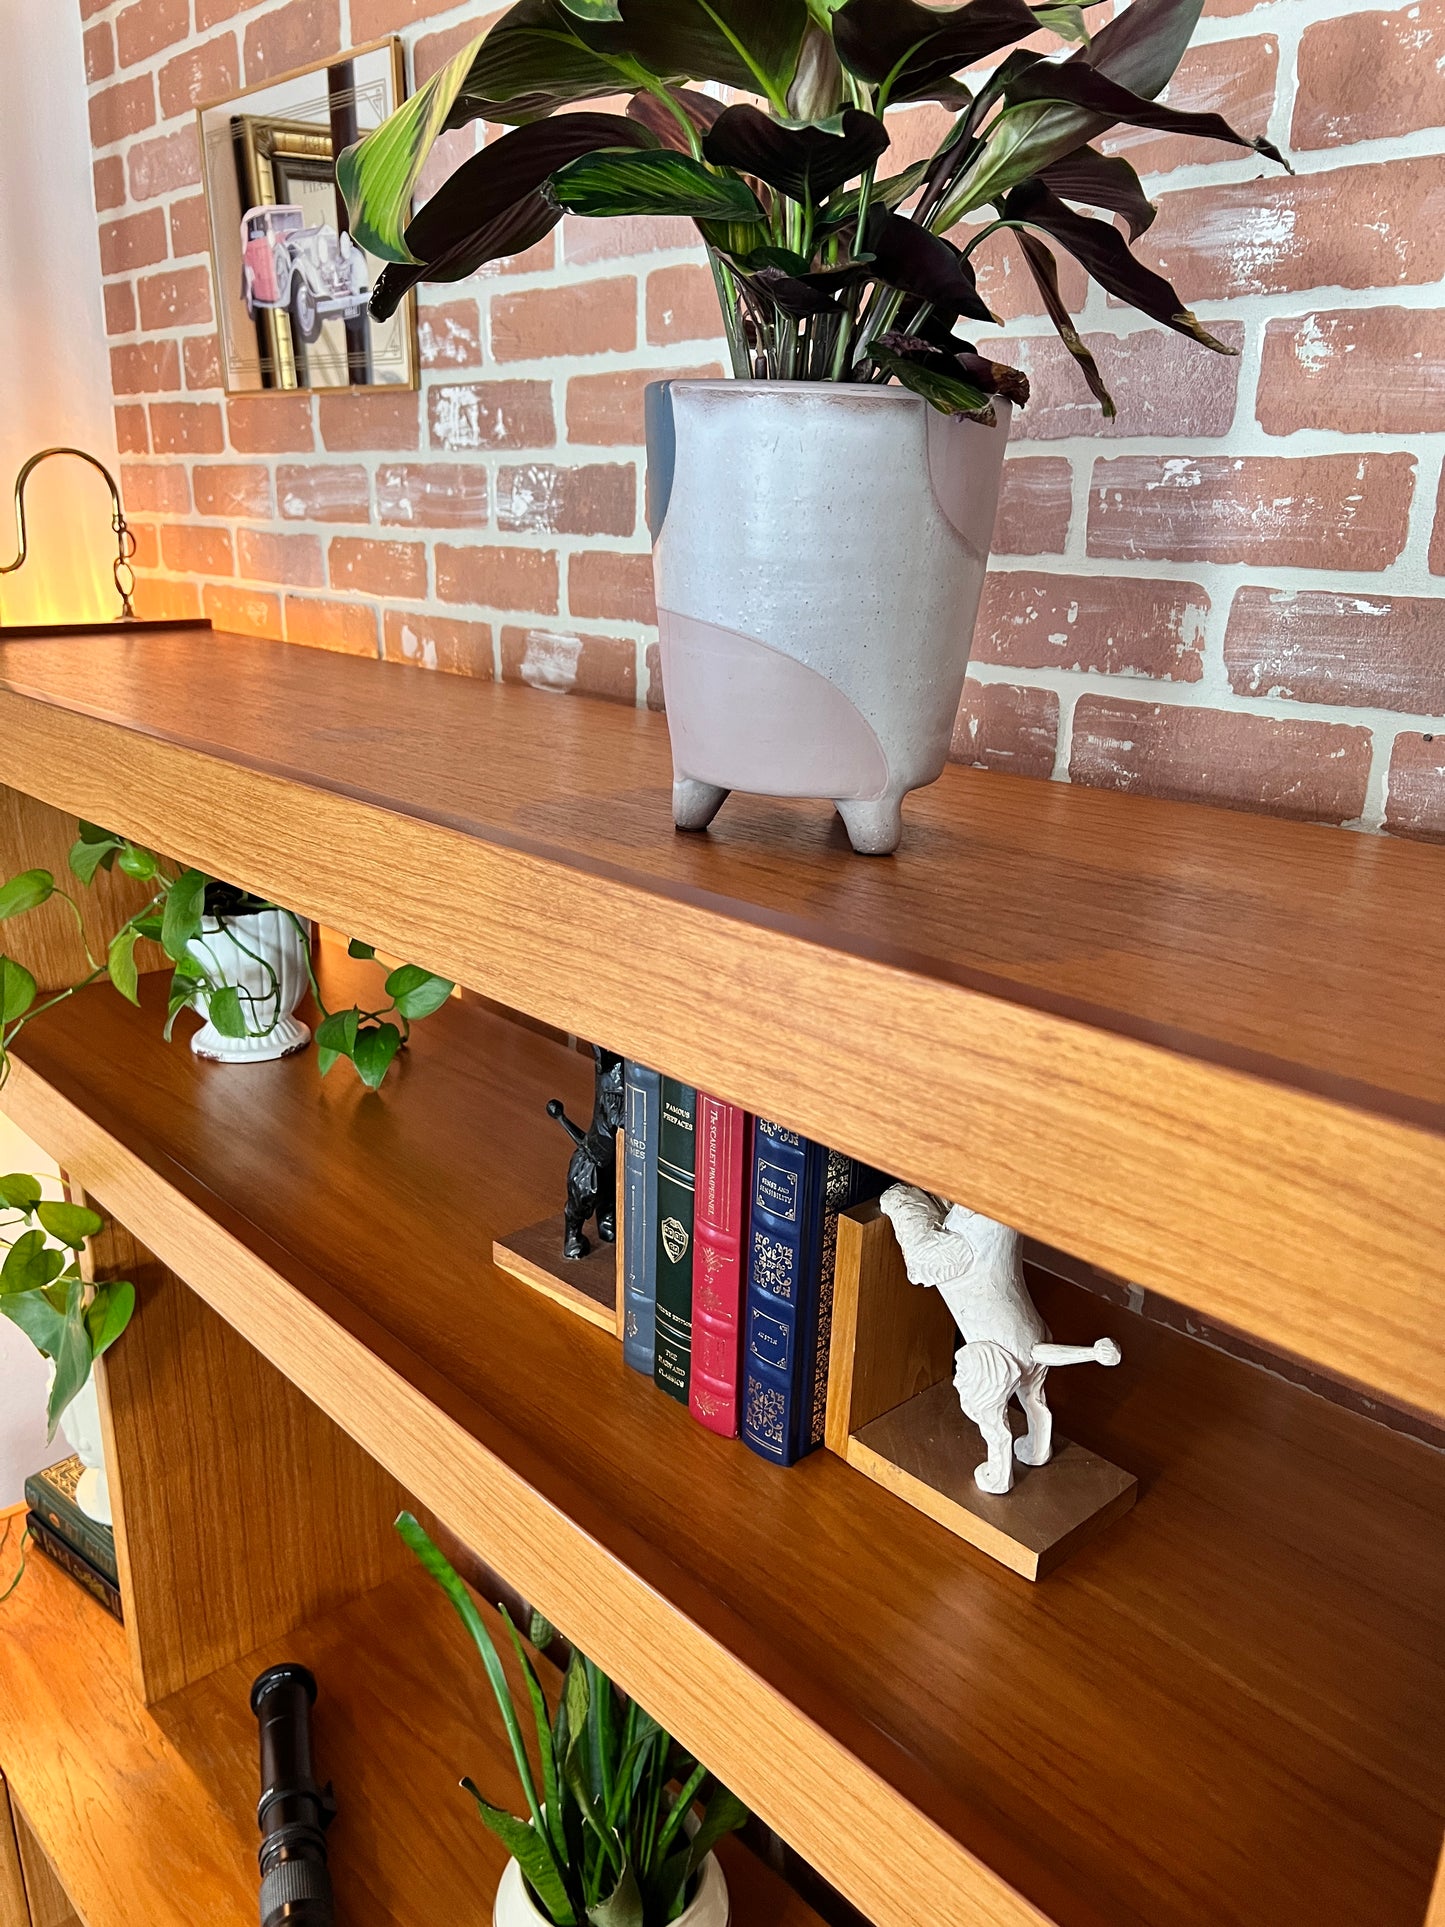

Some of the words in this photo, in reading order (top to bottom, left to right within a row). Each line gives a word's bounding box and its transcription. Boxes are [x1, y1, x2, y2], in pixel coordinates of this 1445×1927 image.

[665, 1102, 690, 1119] FAMOUS
[710, 1109, 718, 1124] The
[663, 1112, 693, 1131] PREFACES
[627, 1143, 646, 1160] MES
[709, 1125, 717, 1167] SCARLET
[707, 1167, 716, 1216] PIMPERNEL
[760, 1184, 793, 1204] SENSIBILITY
[761, 1177, 777, 1190] SENSE
[778, 1186, 790, 1195] AND
[665, 1349, 678, 1361] THE
